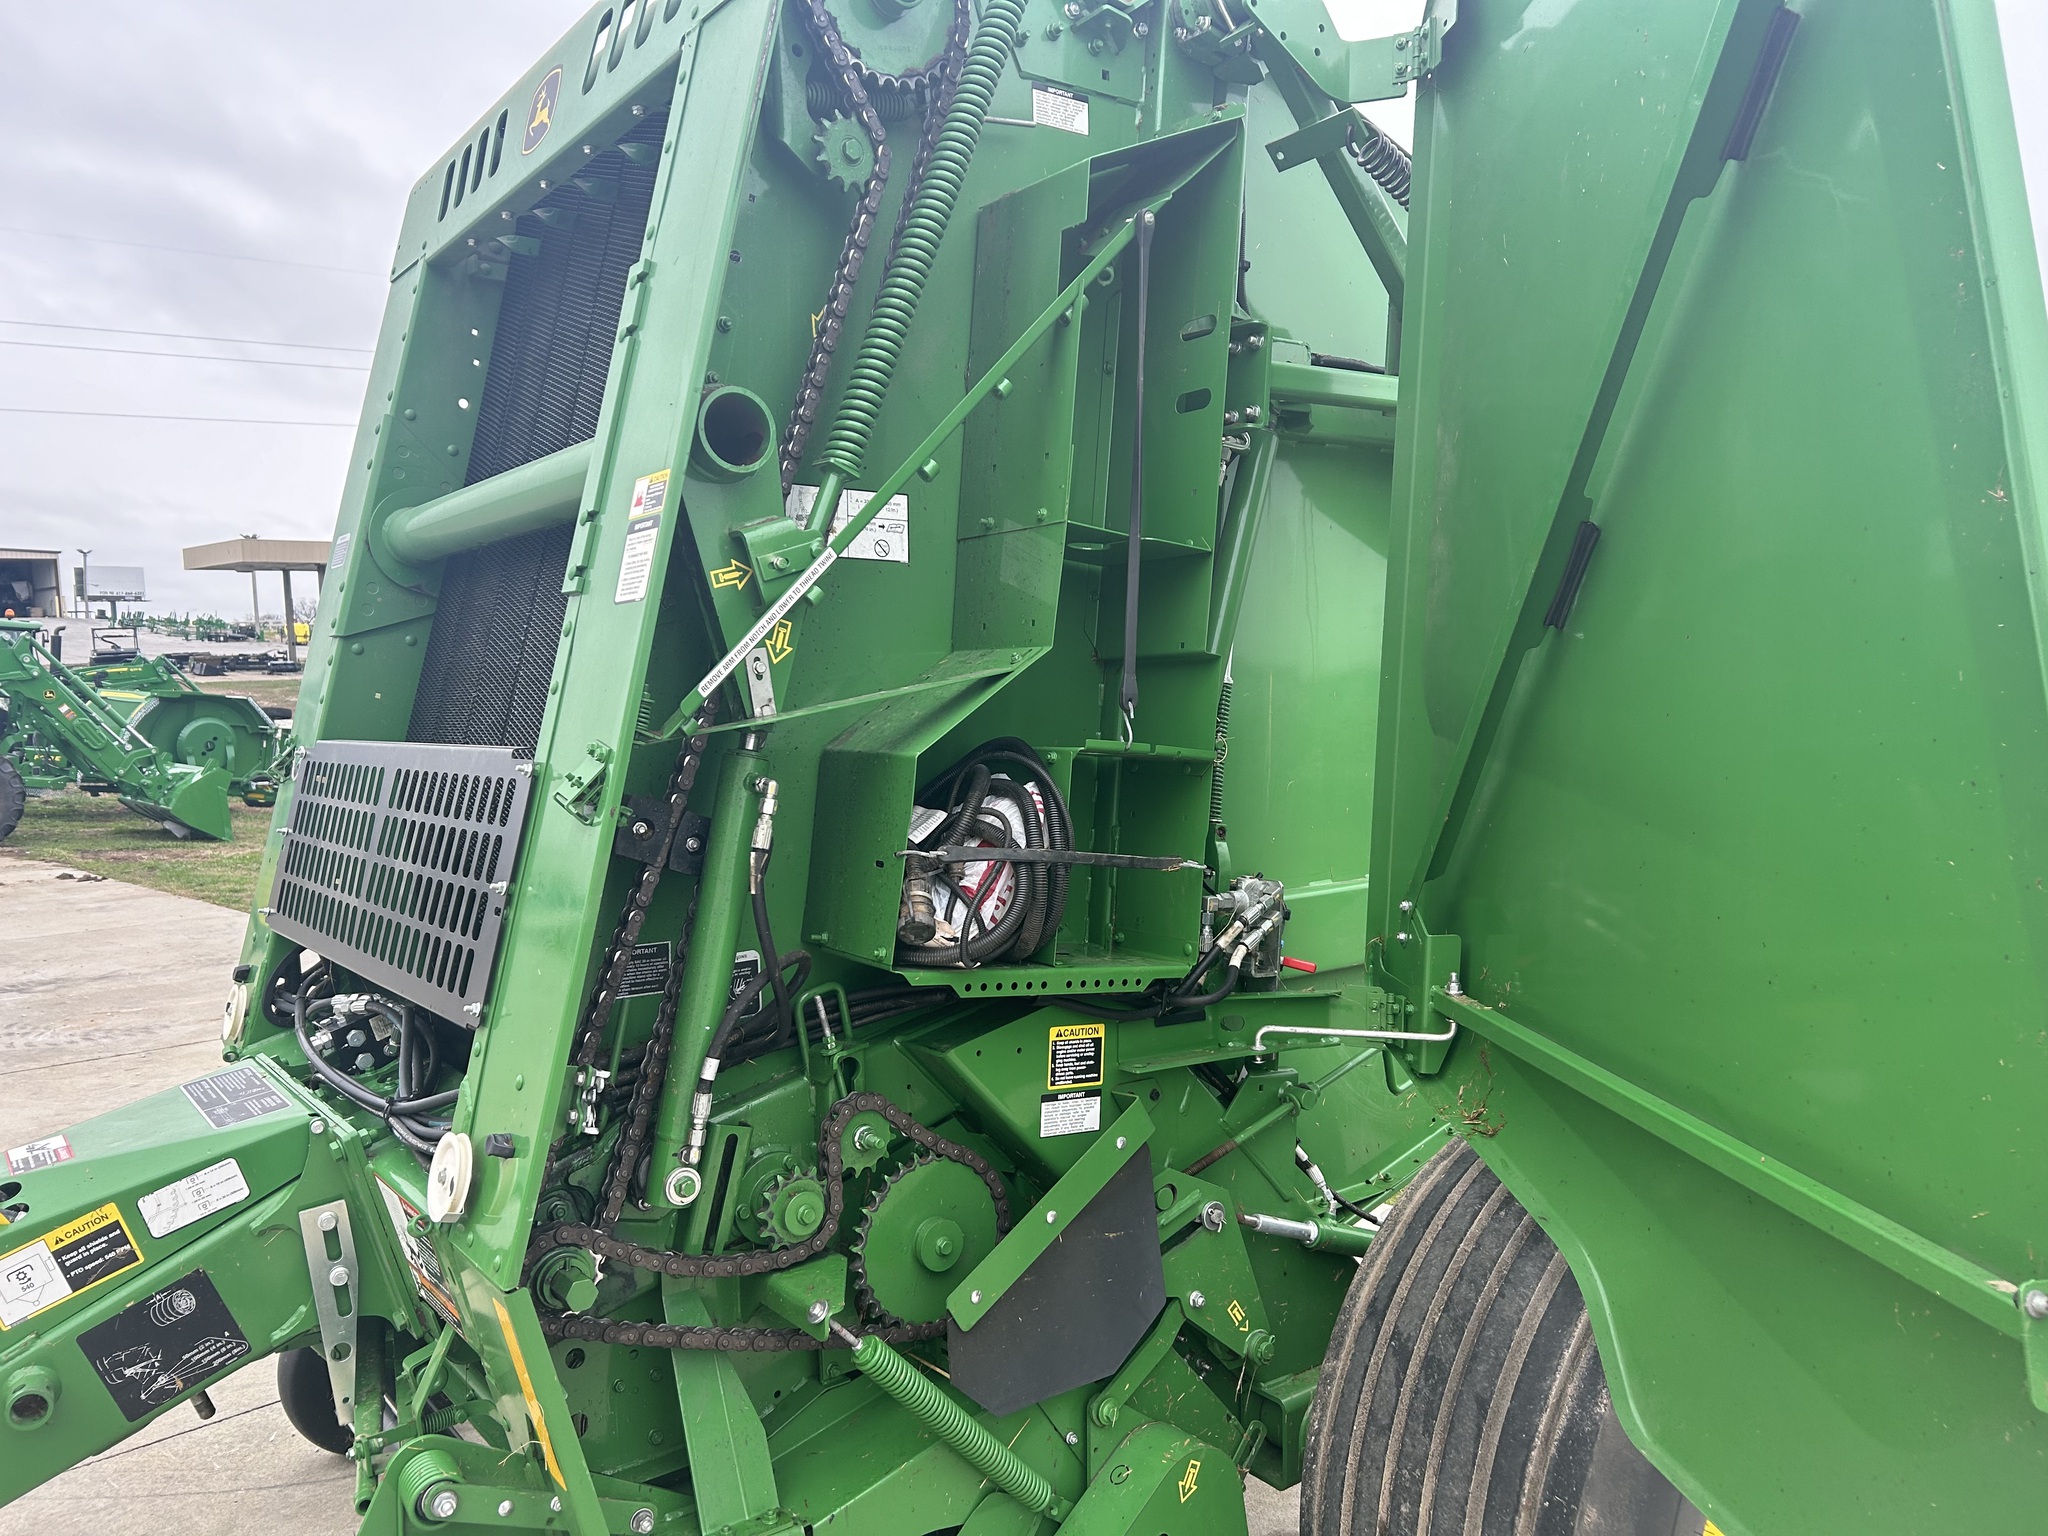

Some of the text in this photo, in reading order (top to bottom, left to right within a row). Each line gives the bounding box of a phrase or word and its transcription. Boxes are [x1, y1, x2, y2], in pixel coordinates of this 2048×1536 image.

[701, 552, 835, 692] REMOVE ARM FROM NOTCH AND LOWER TO THREAD TWINE
[632, 947, 657, 955] ORTANT
[1063, 1027, 1099, 1037] CAUTION
[1058, 1092, 1085, 1100] IMPORTANT
[65, 1213, 109, 1239] CAUTION
[62, 1250, 78, 1260] Keep
[87, 1235, 108, 1248] shields
[109, 1229, 120, 1238] and
[90, 1243, 108, 1254] place.
[70, 1267, 84, 1277] PTO
[84, 1257, 105, 1270] speed:
[104, 1251, 116, 1260] 540
[21, 1282, 35, 1292] 540
